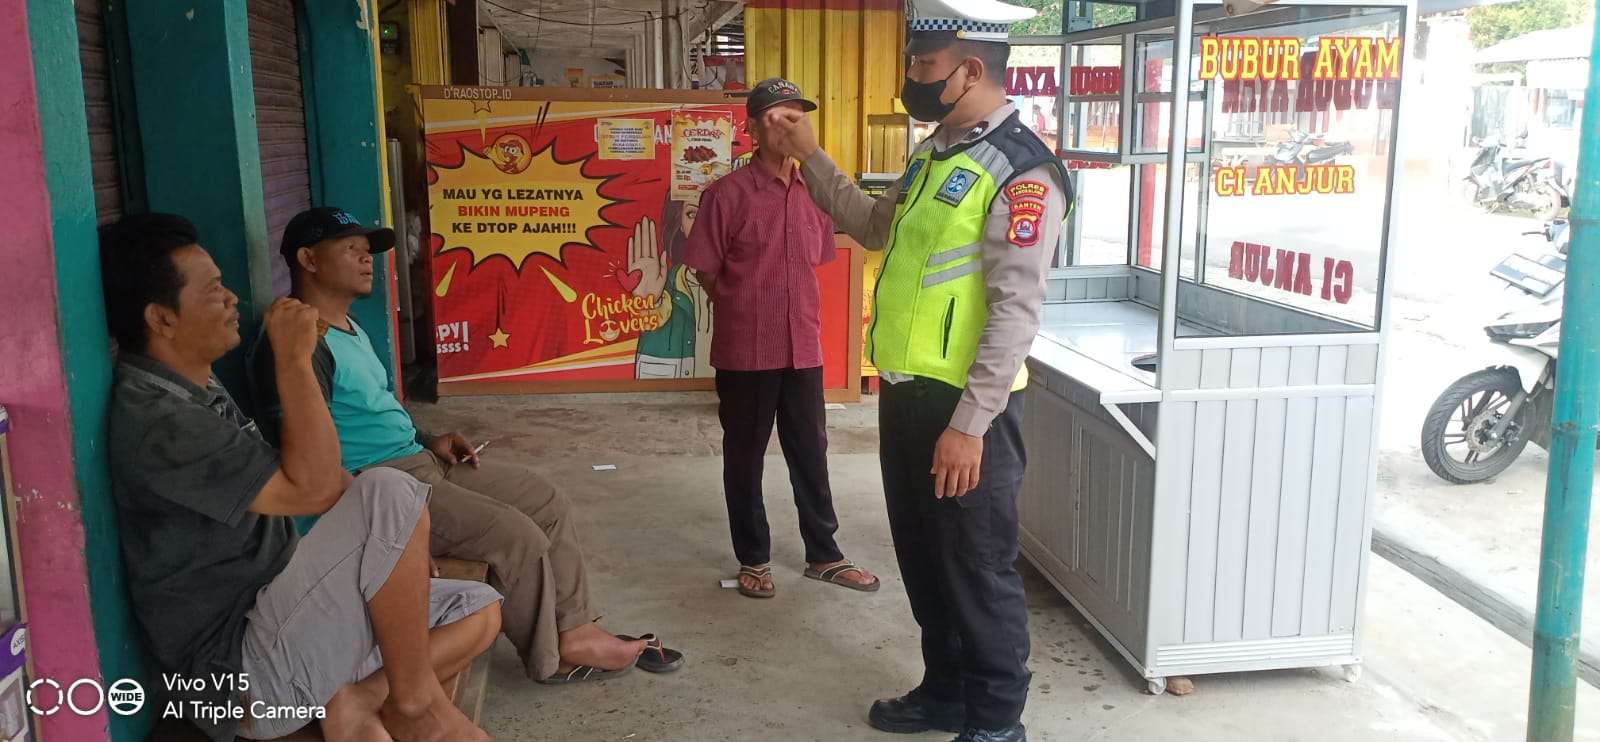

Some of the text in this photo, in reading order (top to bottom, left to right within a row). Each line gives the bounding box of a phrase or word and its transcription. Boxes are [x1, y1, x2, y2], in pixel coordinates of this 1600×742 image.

[1199, 36, 1400, 80] BUBUR AYAM
[1215, 164, 1355, 196] CI ANJUR
[443, 188, 583, 200] MAU YG LEZATNYA
[458, 205, 570, 217] BIKIN MUPENG
[452, 222, 576, 234] KE DTOP AJAH!!!
[582, 292, 654, 321] Chicken
